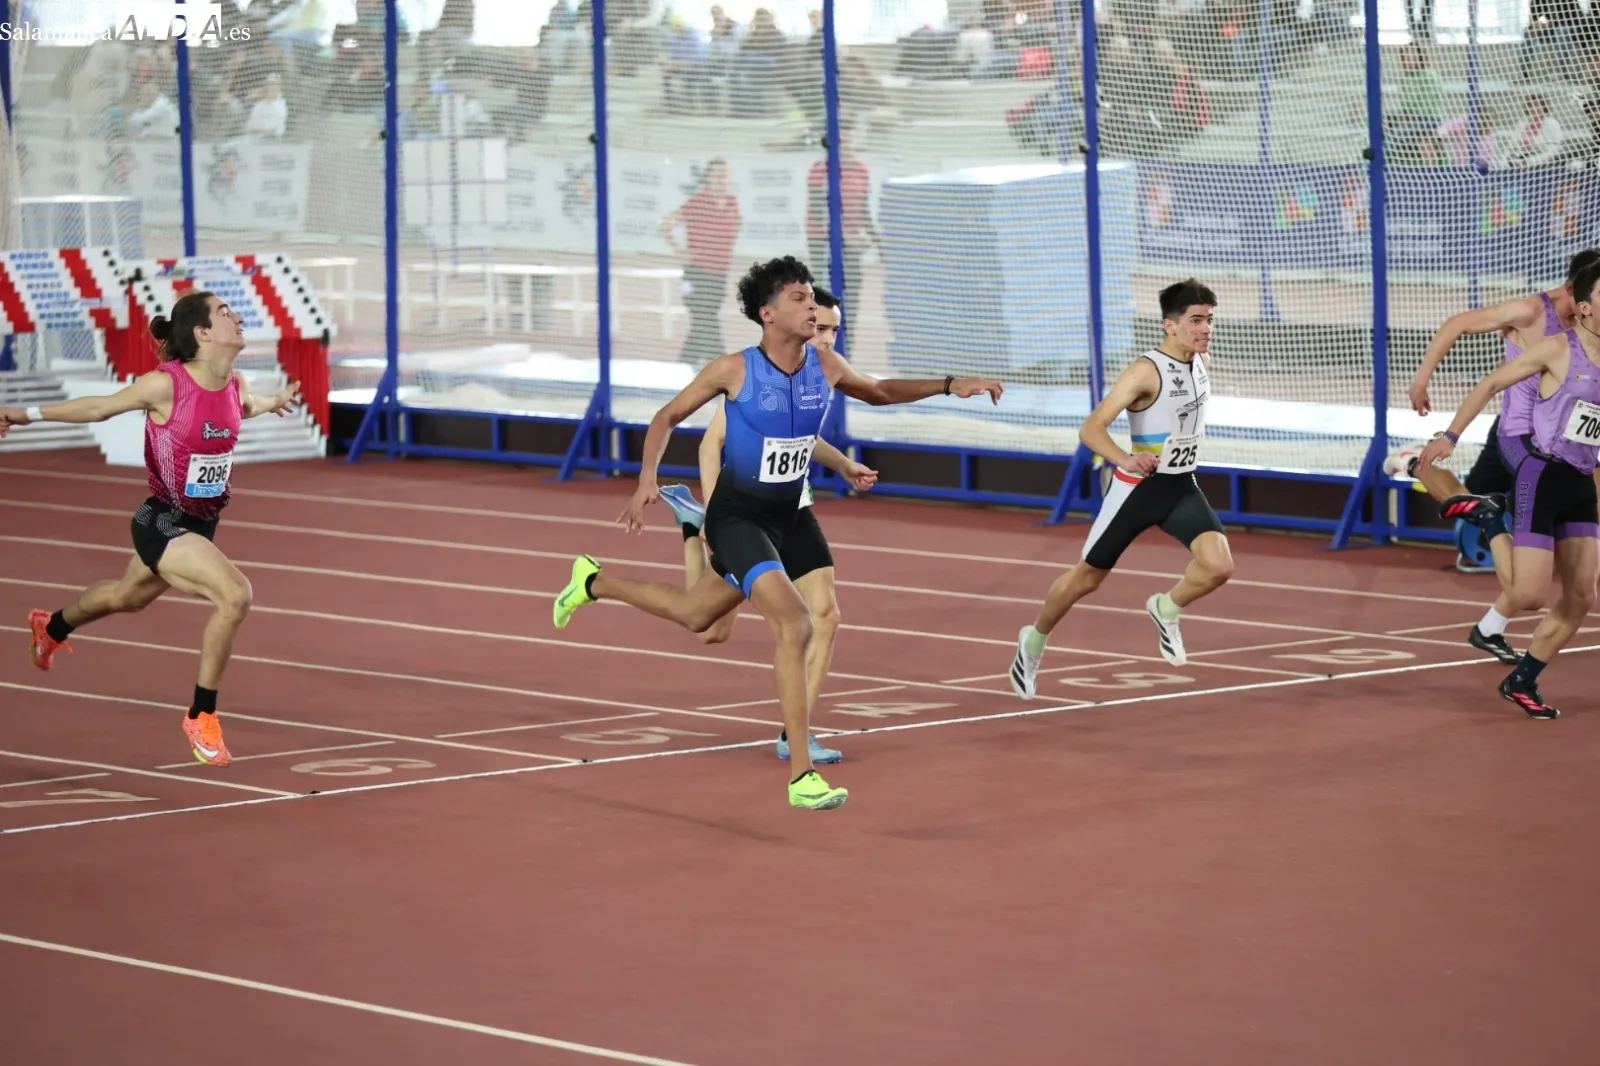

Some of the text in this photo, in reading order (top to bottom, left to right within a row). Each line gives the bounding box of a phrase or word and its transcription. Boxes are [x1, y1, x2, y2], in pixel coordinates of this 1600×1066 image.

[1576, 414, 1600, 439] 706
[766, 447, 808, 476] 1816
[1167, 445, 1198, 467] 225
[196, 464, 228, 484] 2096
[1059, 672, 1196, 689] 3
[830, 702, 956, 718] 4
[560, 726, 721, 746] 5
[290, 757, 437, 777] 6
[0, 788, 161, 808] 7
